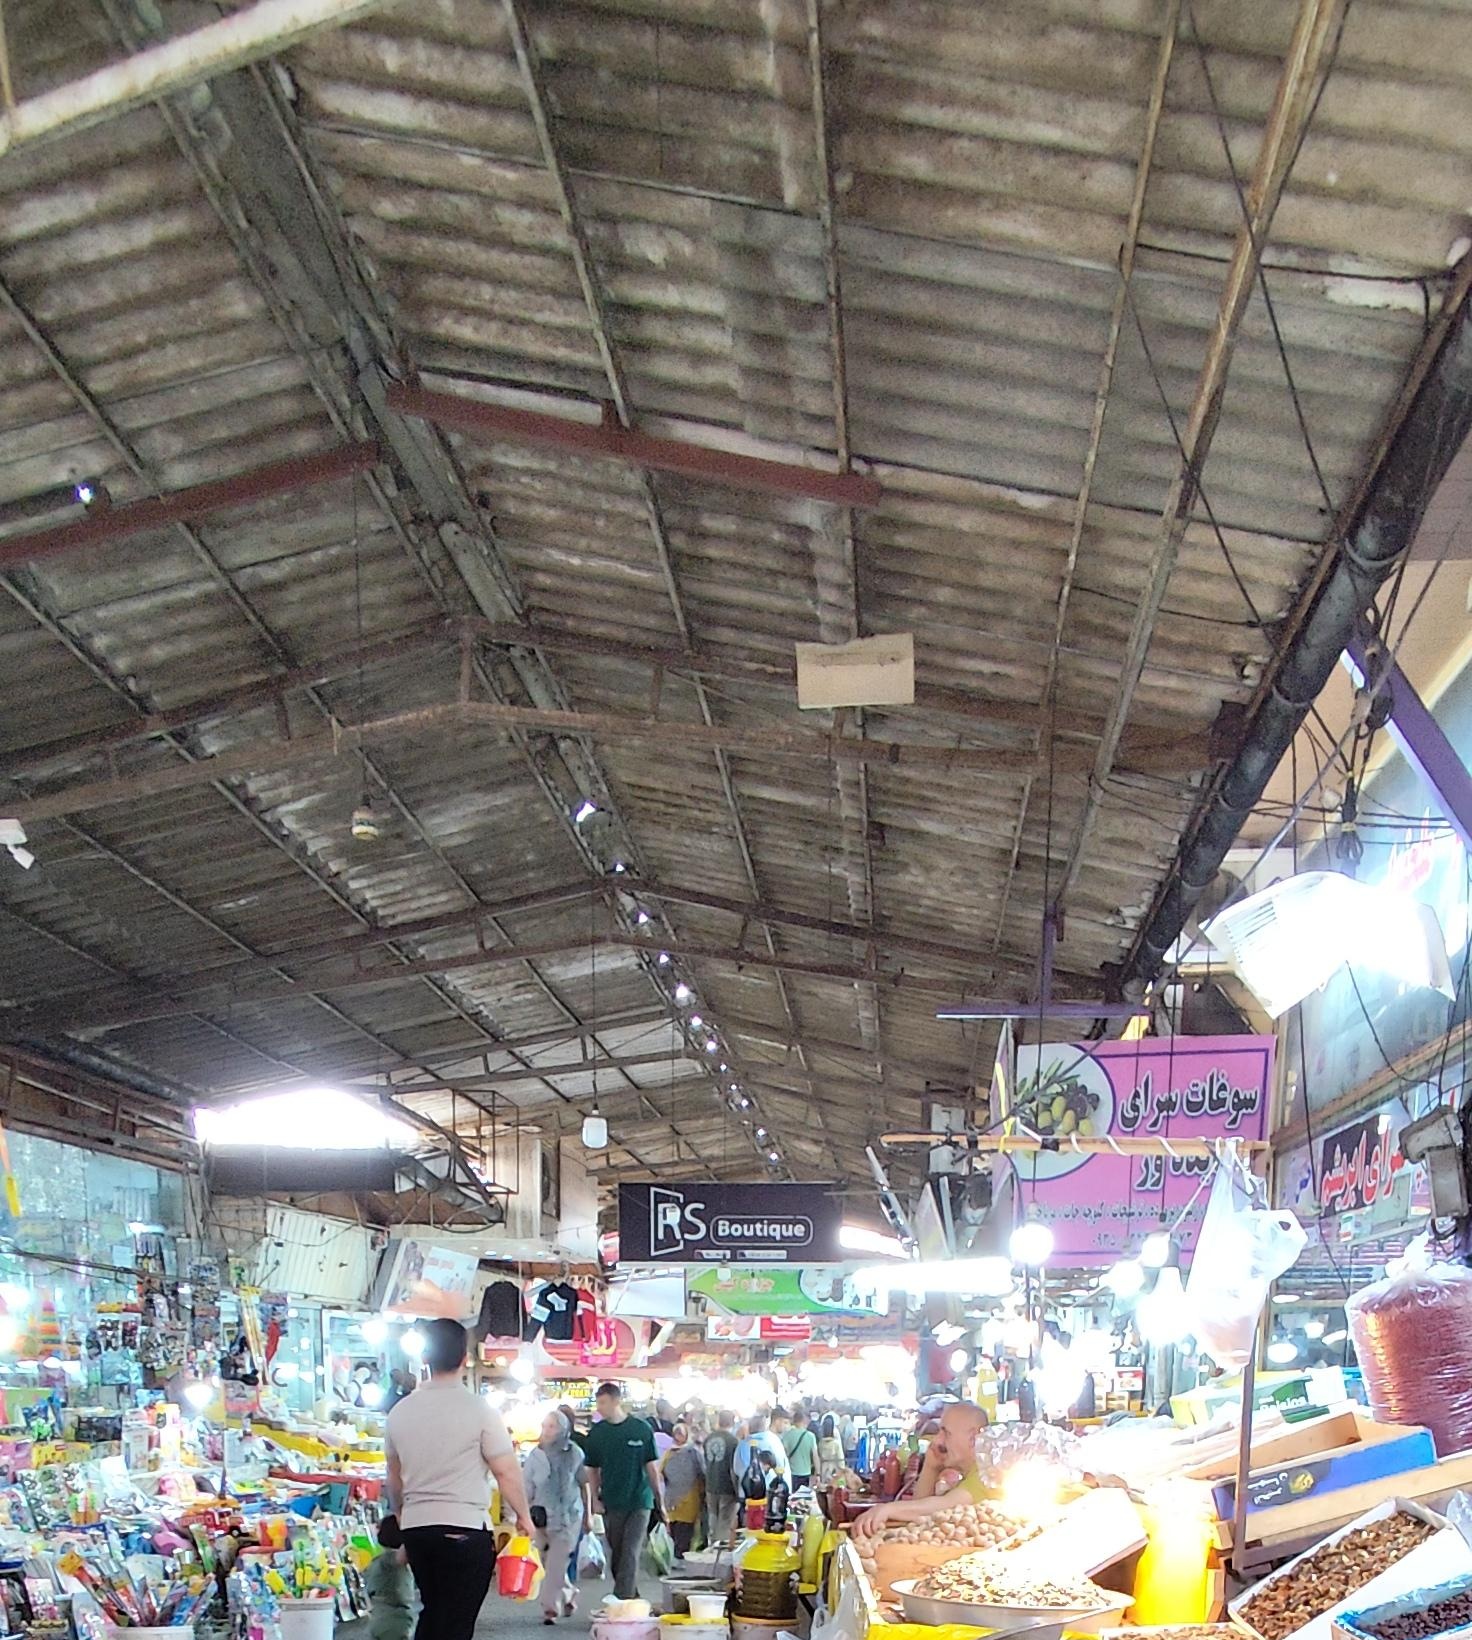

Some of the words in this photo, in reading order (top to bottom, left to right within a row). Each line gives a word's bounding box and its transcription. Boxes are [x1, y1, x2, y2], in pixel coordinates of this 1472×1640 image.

[1118, 1071, 1180, 1131] سرای
[1184, 1068, 1259, 1130] سوغات
[657, 1203, 707, 1240] RS
[718, 1219, 806, 1241] Boutique
